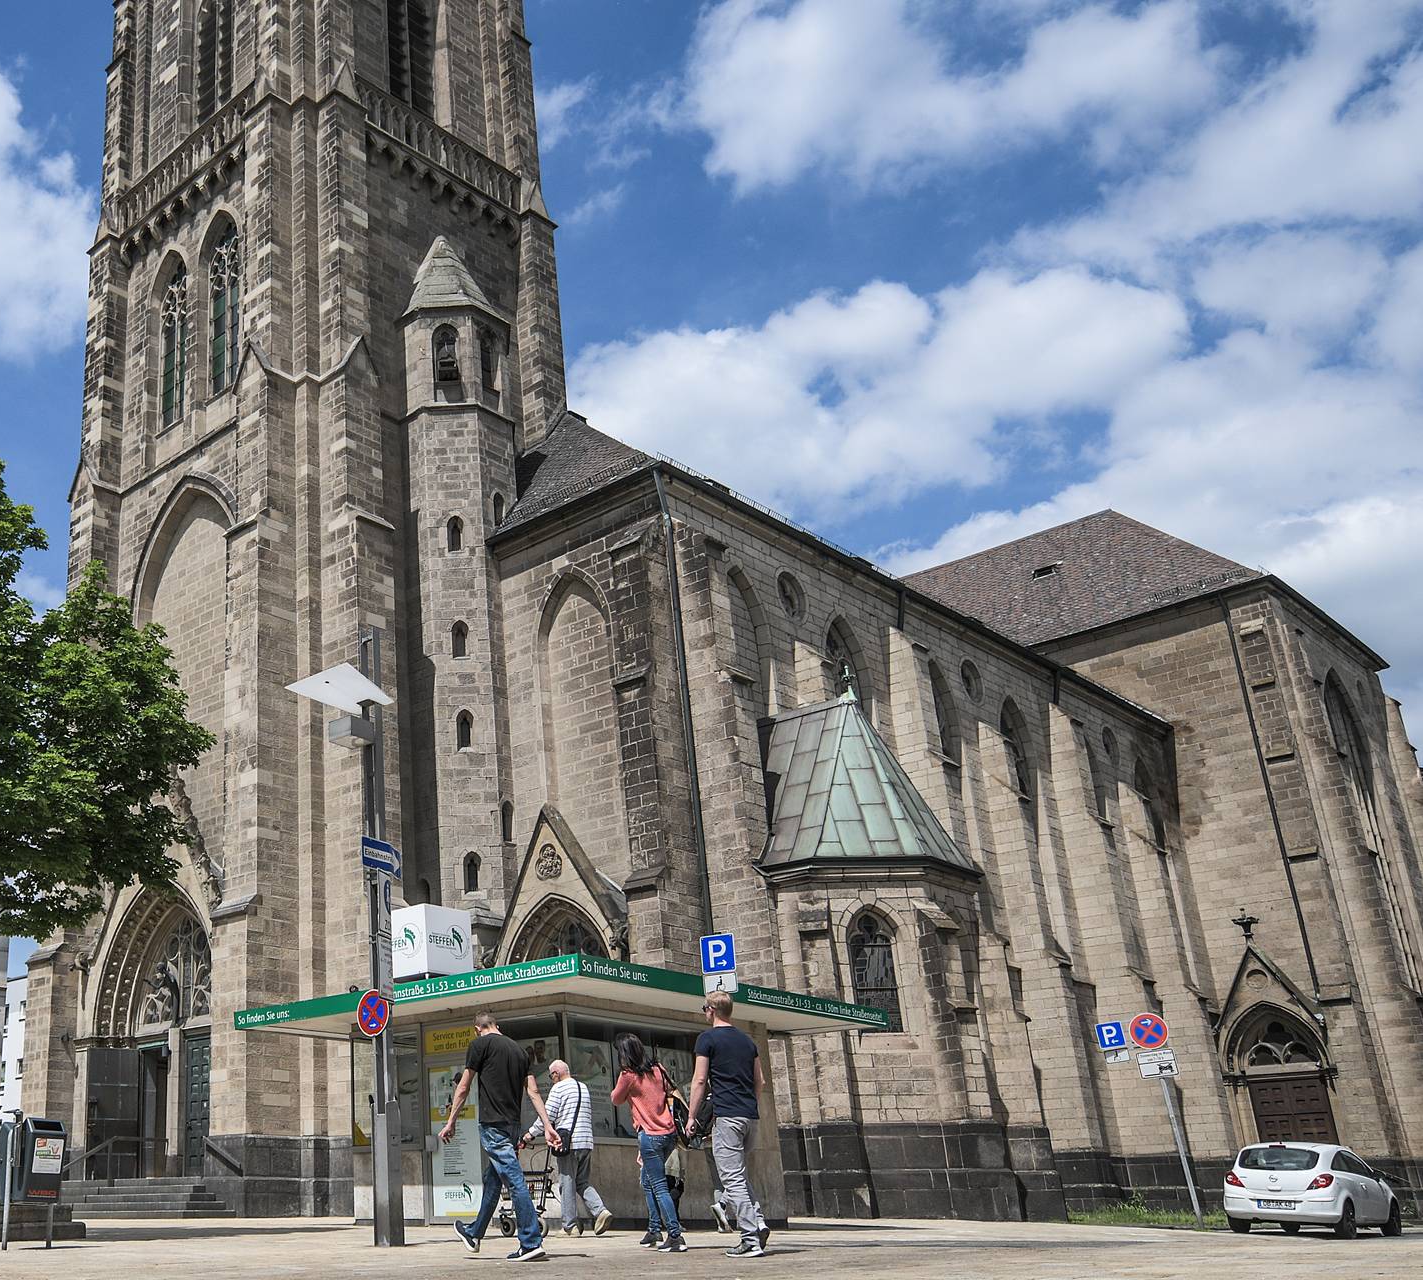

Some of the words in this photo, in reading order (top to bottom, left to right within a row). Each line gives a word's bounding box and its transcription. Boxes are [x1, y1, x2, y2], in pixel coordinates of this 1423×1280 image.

[428, 934, 455, 947] STEFFEN
[708, 940, 726, 968] P
[393, 984, 425, 999] nnstraße
[426, 980, 449, 994] 51-53
[456, 979, 468, 989] ca.
[470, 973, 492, 987] 150m
[494, 969, 514, 983] linke
[515, 959, 570, 979] Straßenseite!
[582, 959, 592, 973] So
[594, 960, 618, 977] finden
[619, 966, 631, 979] Sie
[632, 971, 649, 983] uns:
[747, 988, 794, 1007] Stöckmannstraße
[795, 997, 811, 1009] 51-53
[815, 1003, 823, 1012] ca.
[824, 1003, 839, 1014] 150m
[839, 1005, 852, 1017] linke
[851, 1007, 883, 1022] Straßenseite!
[237, 1014, 246, 1025] So
[246, 1012, 266, 1024] finden
[266, 1011, 276, 1022] Sie
[276, 1009, 290, 1020] uns:
[432, 1031, 454, 1042] Service
[455, 1029, 471, 1039] rund
[1101, 1025, 1117, 1046] P
[433, 1043, 444, 1051] um
[445, 1041, 457, 1050] den
[444, 1191, 466, 1200] STEFFEN
